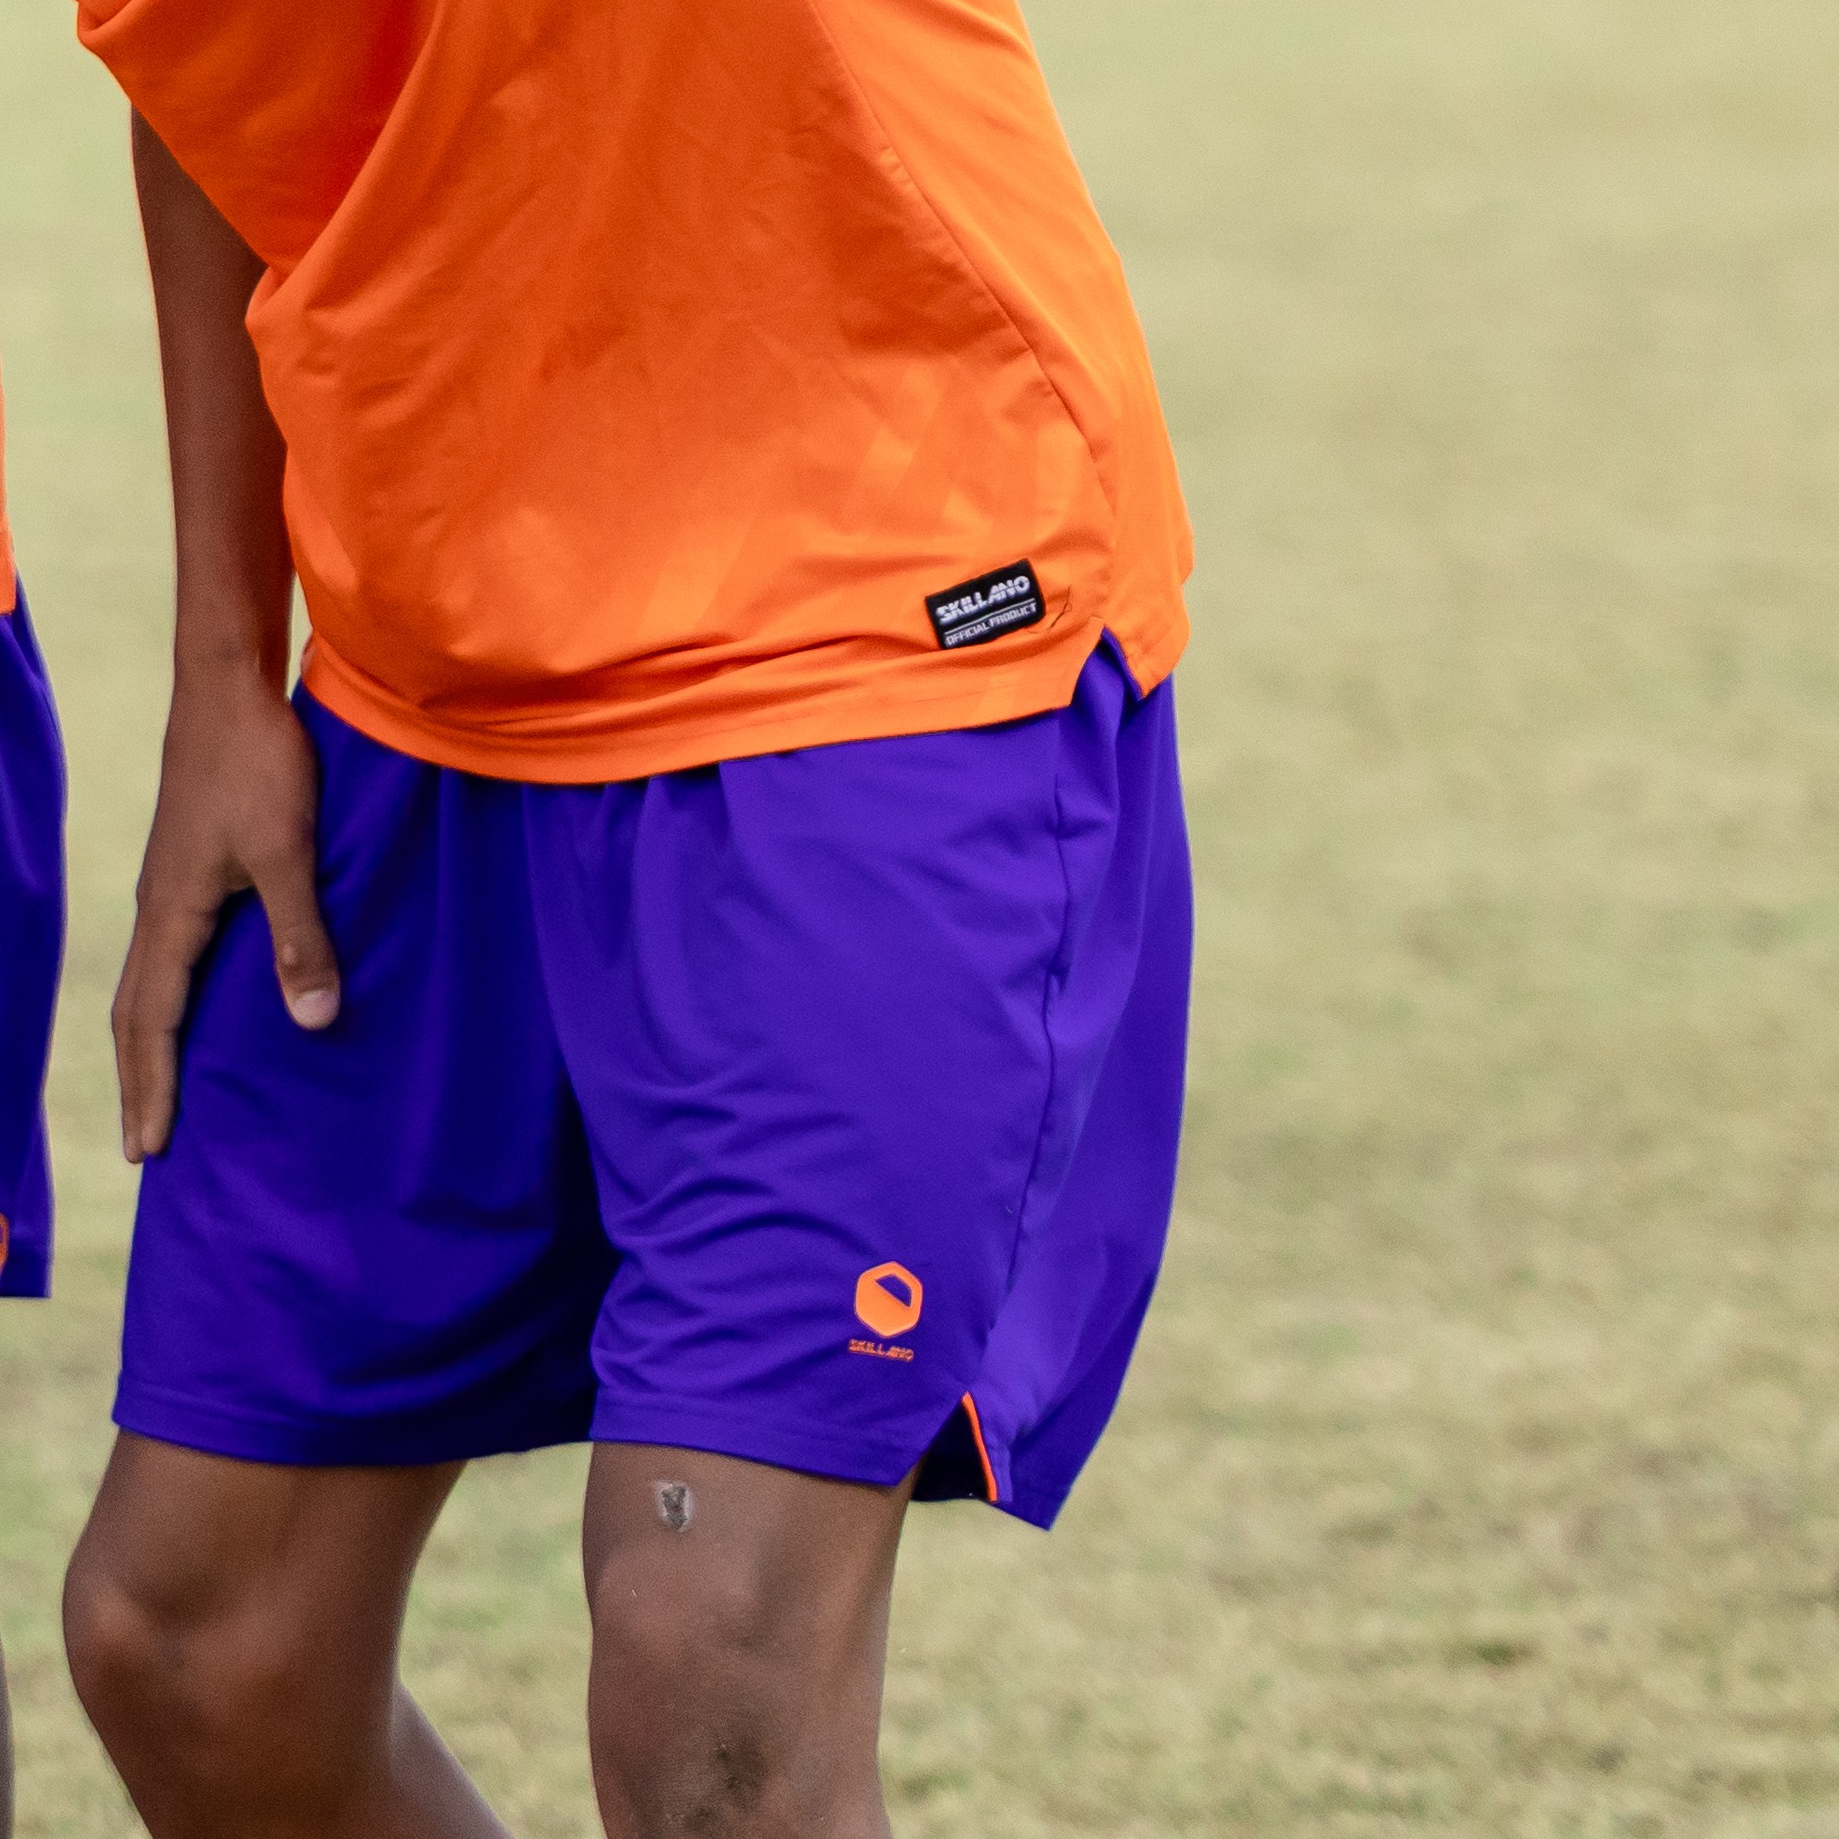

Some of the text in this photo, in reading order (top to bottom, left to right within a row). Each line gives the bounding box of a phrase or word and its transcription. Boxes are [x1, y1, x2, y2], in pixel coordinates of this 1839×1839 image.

[936, 576, 1030, 624] SKILLANO
[945, 602, 1037, 647] OFFICIAL PRODUCT
